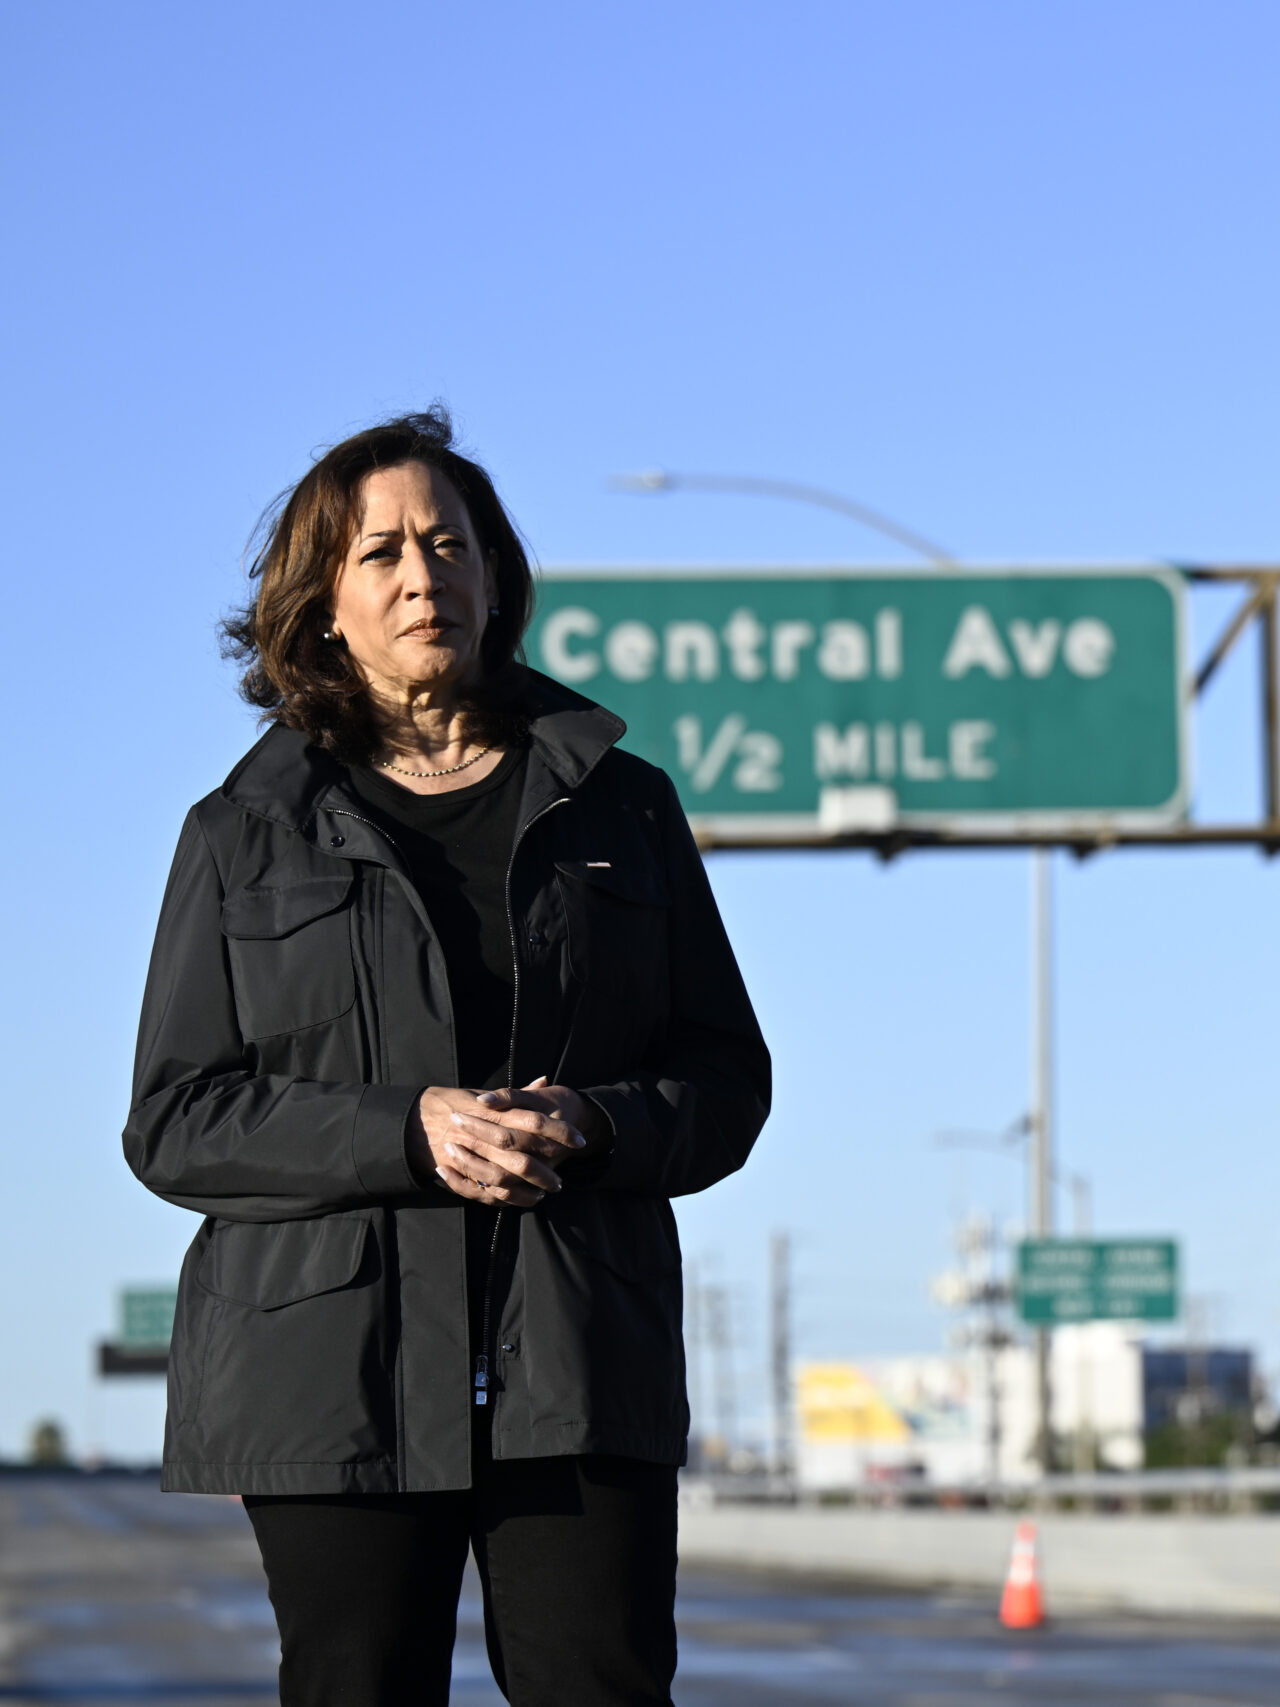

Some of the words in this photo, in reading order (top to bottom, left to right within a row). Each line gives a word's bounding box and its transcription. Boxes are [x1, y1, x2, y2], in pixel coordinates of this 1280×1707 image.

[540, 606, 902, 683] Central
[942, 605, 1114, 679] Ave
[813, 720, 996, 780] MILE
